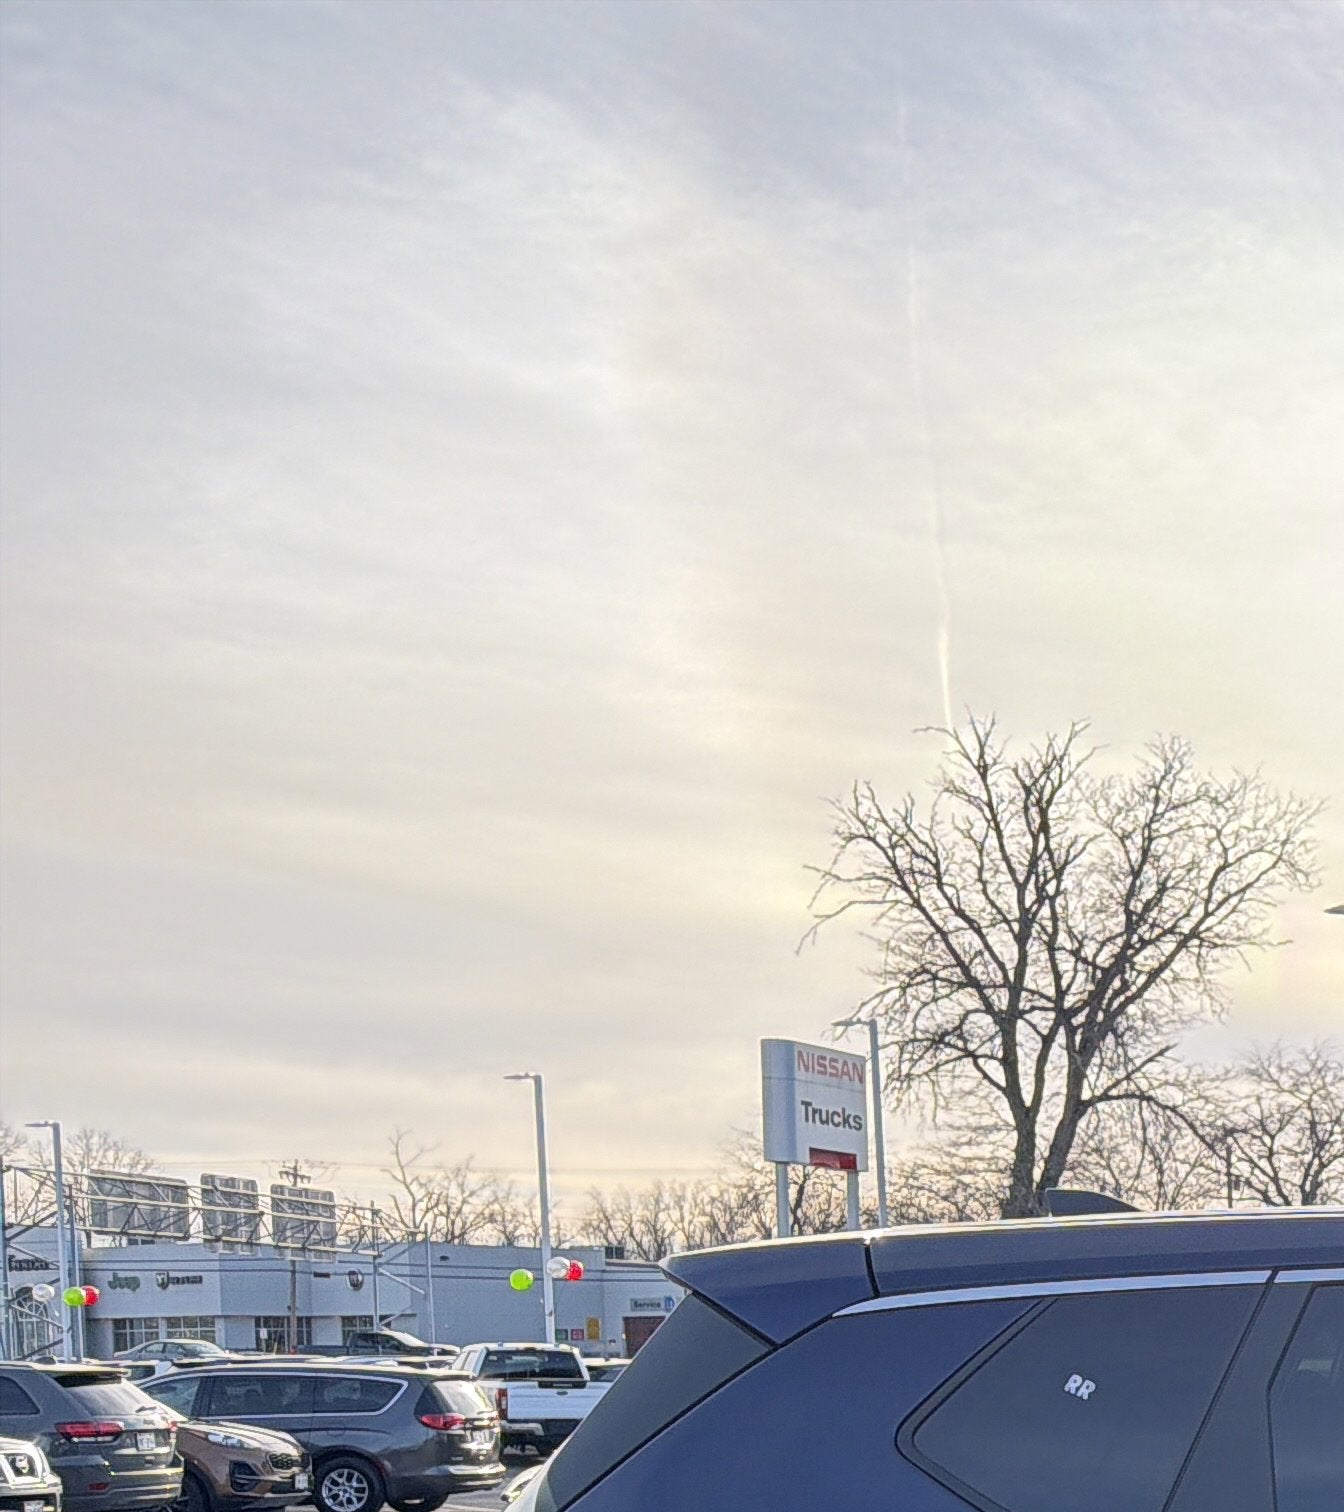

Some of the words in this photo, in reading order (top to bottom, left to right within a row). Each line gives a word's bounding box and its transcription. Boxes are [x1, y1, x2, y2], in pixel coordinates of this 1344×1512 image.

[797, 1050, 865, 1084] NISSAN
[801, 1099, 863, 1131] Trucks
[633, 1300, 661, 1308] Service
[1064, 1374, 1096, 1400] RR
